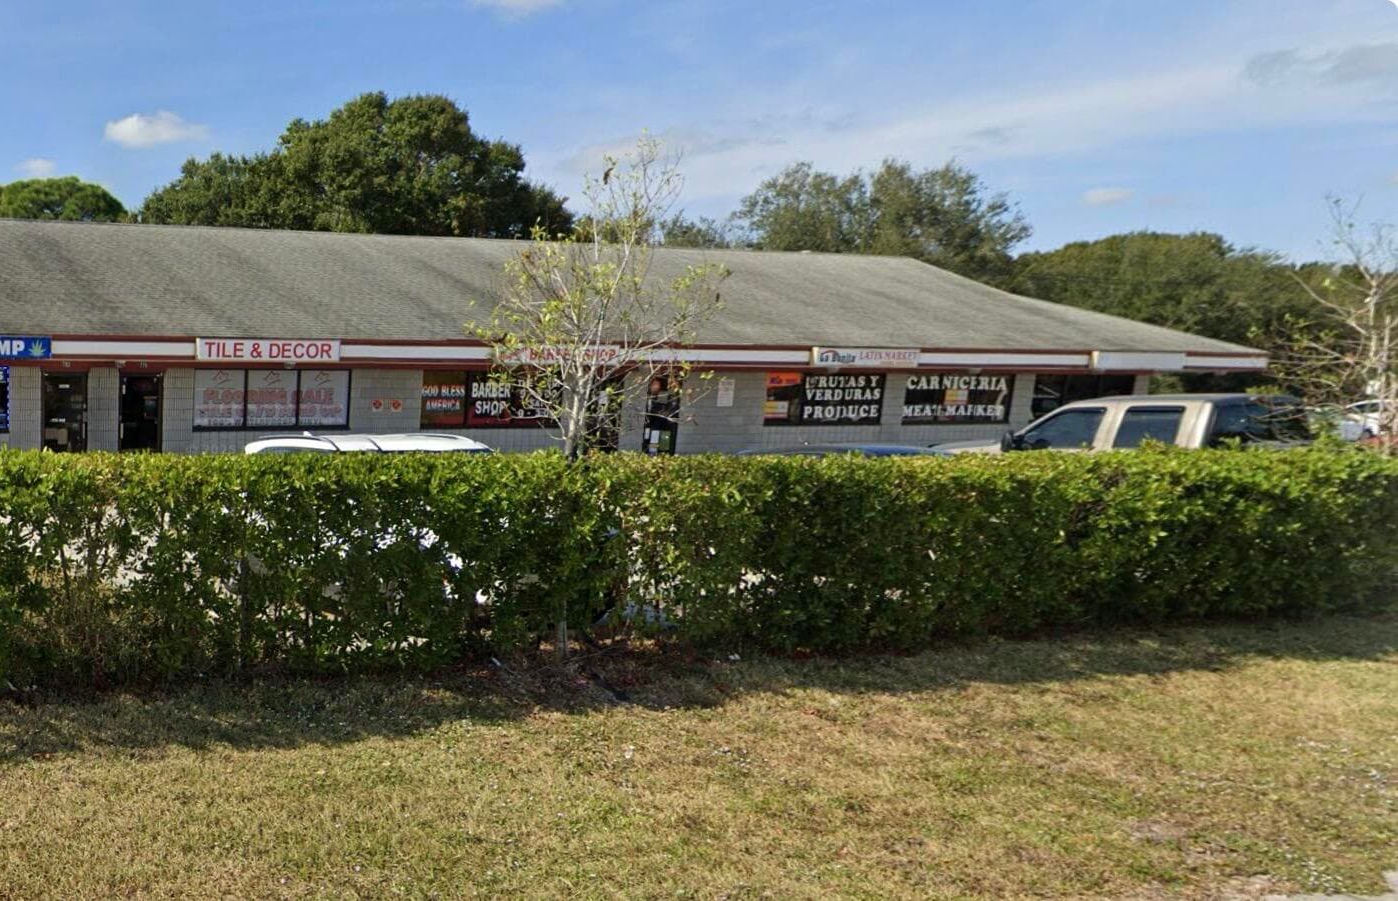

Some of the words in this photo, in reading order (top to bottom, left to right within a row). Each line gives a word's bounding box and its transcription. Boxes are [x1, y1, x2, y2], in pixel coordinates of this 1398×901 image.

[205, 342, 244, 358] TILE
[250, 343, 262, 358] &
[268, 343, 332, 359] DECOR
[870, 376, 880, 387] Y
[906, 376, 1008, 390] CARNICERIA
[422, 384, 439, 397] GOD
[441, 385, 466, 397] BLESS
[471, 382, 512, 398] BARBER
[805, 388, 881, 401] VERDURAS
[425, 399, 461, 411] AMERICA
[475, 401, 507, 415] SHOP
[803, 405, 879, 418] PRODUCE
